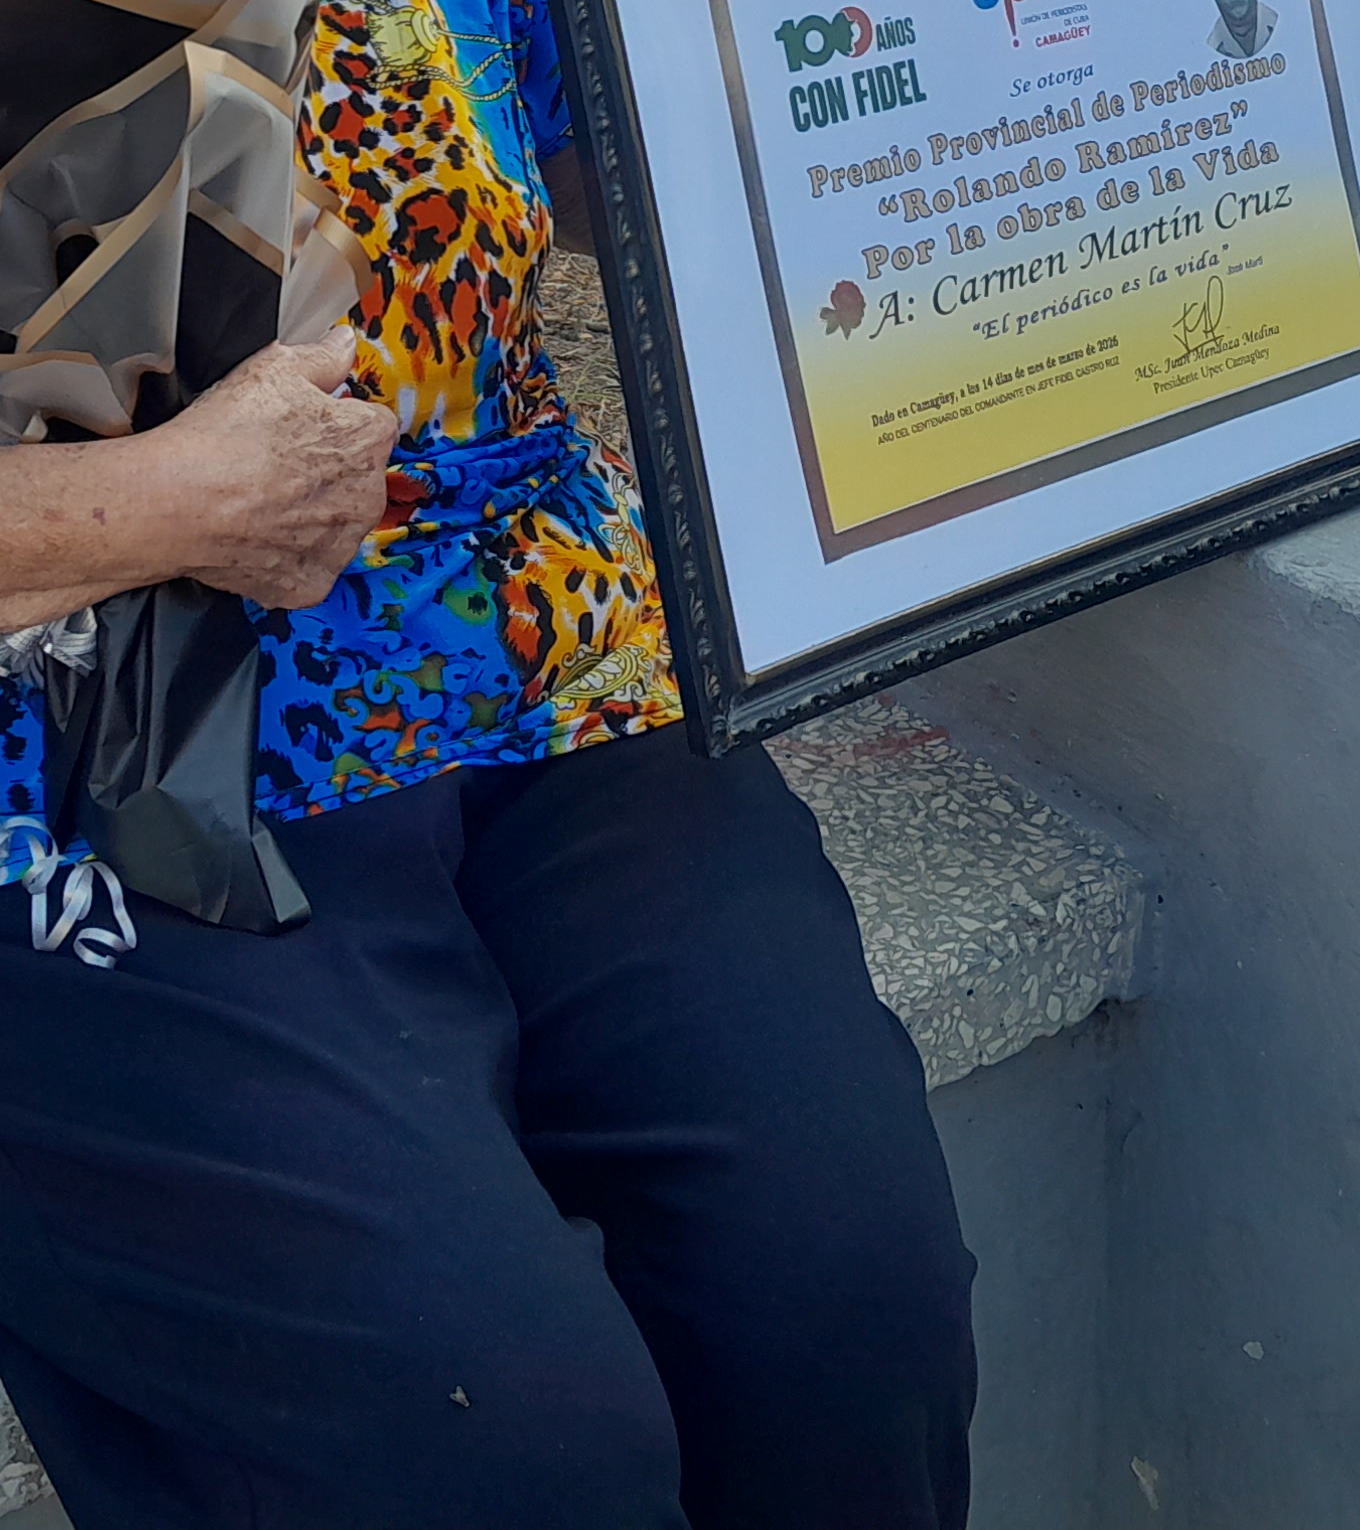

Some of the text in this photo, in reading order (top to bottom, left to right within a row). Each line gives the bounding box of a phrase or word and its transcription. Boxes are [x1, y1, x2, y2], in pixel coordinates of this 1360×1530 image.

[774, 6, 916, 73] 100 AÑOS
[1035, 25, 1091, 47] CAMAGÜEY
[789, 58, 927, 133] CON FIDEL
[1009, 64, 1094, 98] Se otorga
[807, 52, 1286, 198] Premio Provincial de Periodismo
[878, 99, 1248, 222] “Rolando Ramírez”
[861, 139, 1279, 279] Por la obra de la Vida
[868, 183, 1293, 339] A: Carmen Martín Cruz
[1015, 288, 1113, 335] periódico
[1121, 278, 1141, 294] es
[1148, 266, 1168, 286] la
[871, 410, 895, 427] Dado
[897, 408, 909, 419] en
[910, 392, 959, 415] Camagüey,
[960, 388, 966, 398] a
[967, 383, 980, 395] los
[982, 377, 993, 391] 14
[1015, 366, 1025, 379] de
[1027, 362, 1044, 375] mes
[1046, 356, 1057, 369] de
[1058, 349, 1084, 365] marzo
[1086, 343, 1096, 356] de
[1097, 335, 1119, 352] 2026
[1153, 371, 1199, 394] Presidente
[1225, 347, 1270, 369] Camagüey
[1164, 352, 1190, 374] Juan
[1193, 337, 1240, 363] Mendoza
[1242, 324, 1280, 345] Medina
[960, 406, 974, 417] DEL
[1025, 384, 1036, 396] EN
